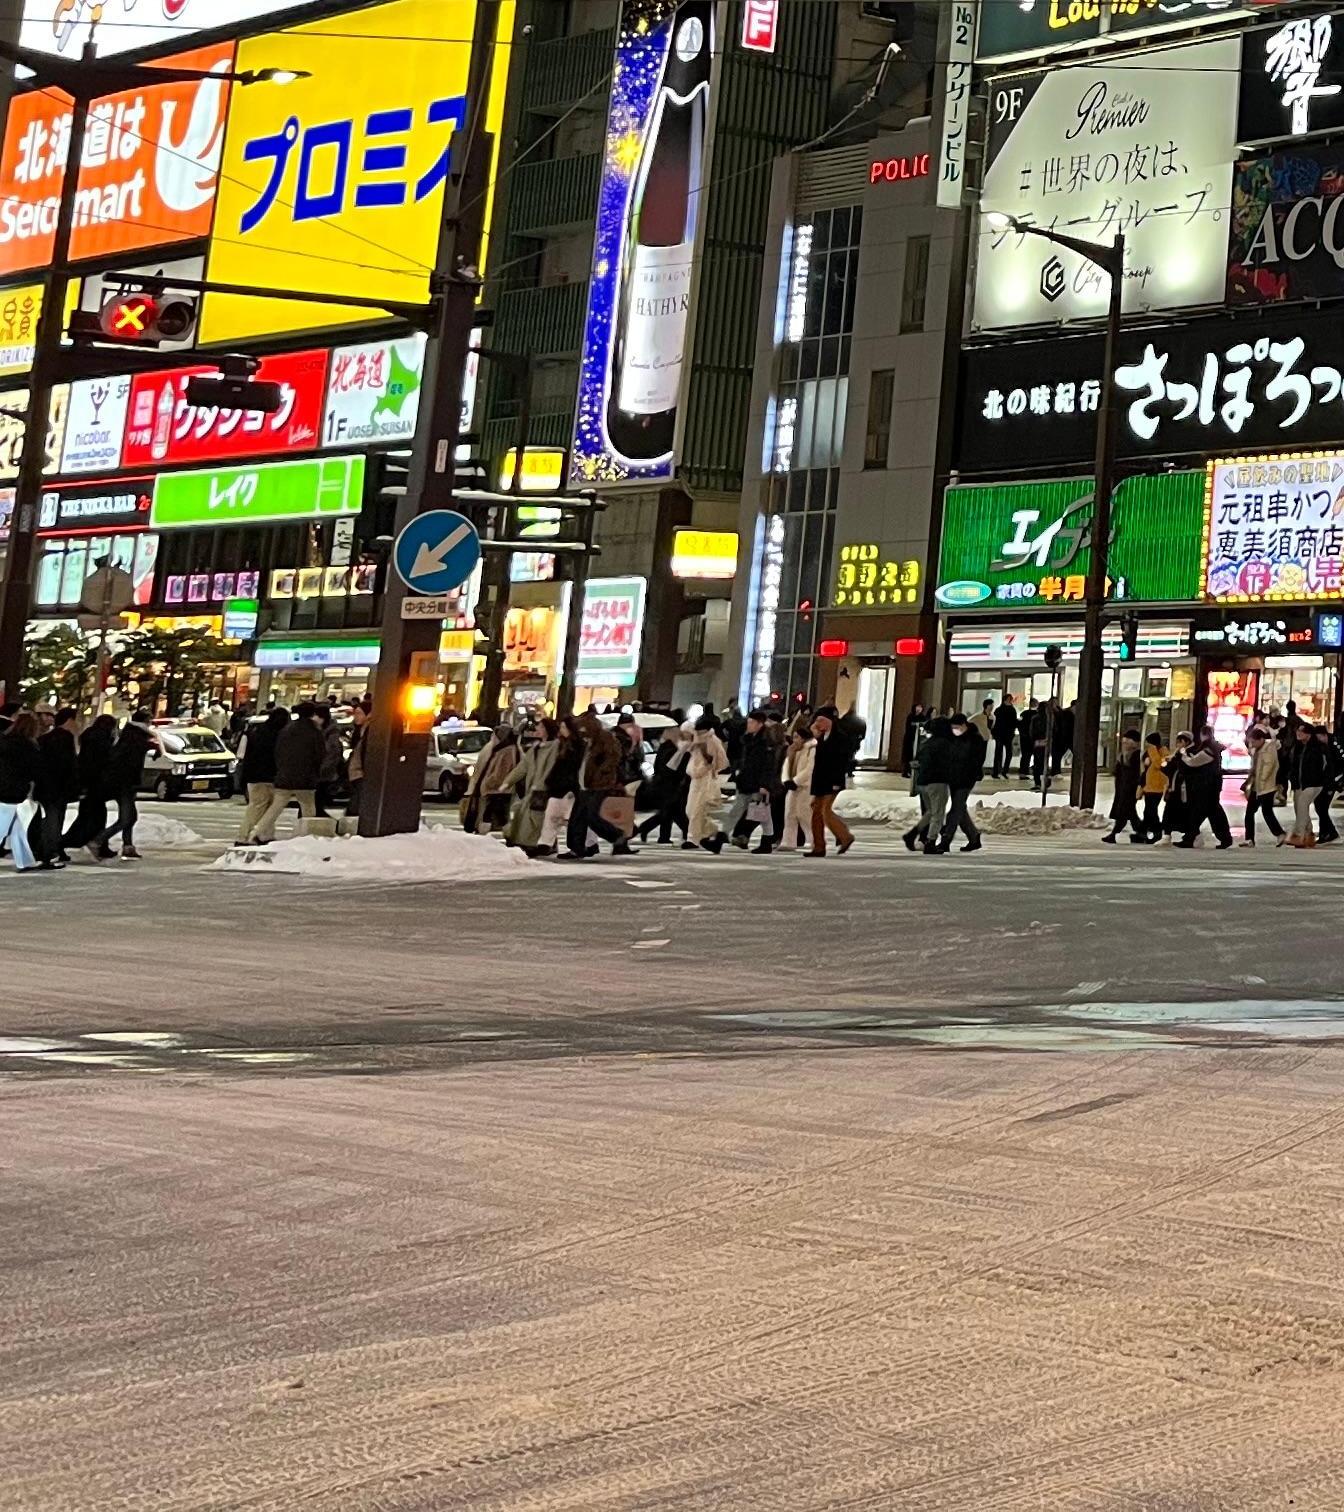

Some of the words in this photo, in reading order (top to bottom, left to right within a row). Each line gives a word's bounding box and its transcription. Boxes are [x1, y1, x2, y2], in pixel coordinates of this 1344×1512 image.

[943, 62, 970, 182] グリーンビル
[996, 88, 1024, 124] 9F
[0, 168, 146, 243] Seicmart
[636, 292, 689, 317] HATHYR
[331, 348, 385, 393] 北海道
[982, 380, 1101, 420] 北の味紀行
[327, 410, 348, 442] 1F
[208, 473, 259, 510] レイク
[1237, 461, 1331, 488] 昼飲みの聖地
[1217, 489, 1332, 525] 元祖串かつ
[1215, 524, 1344, 562] 恵美須商店
